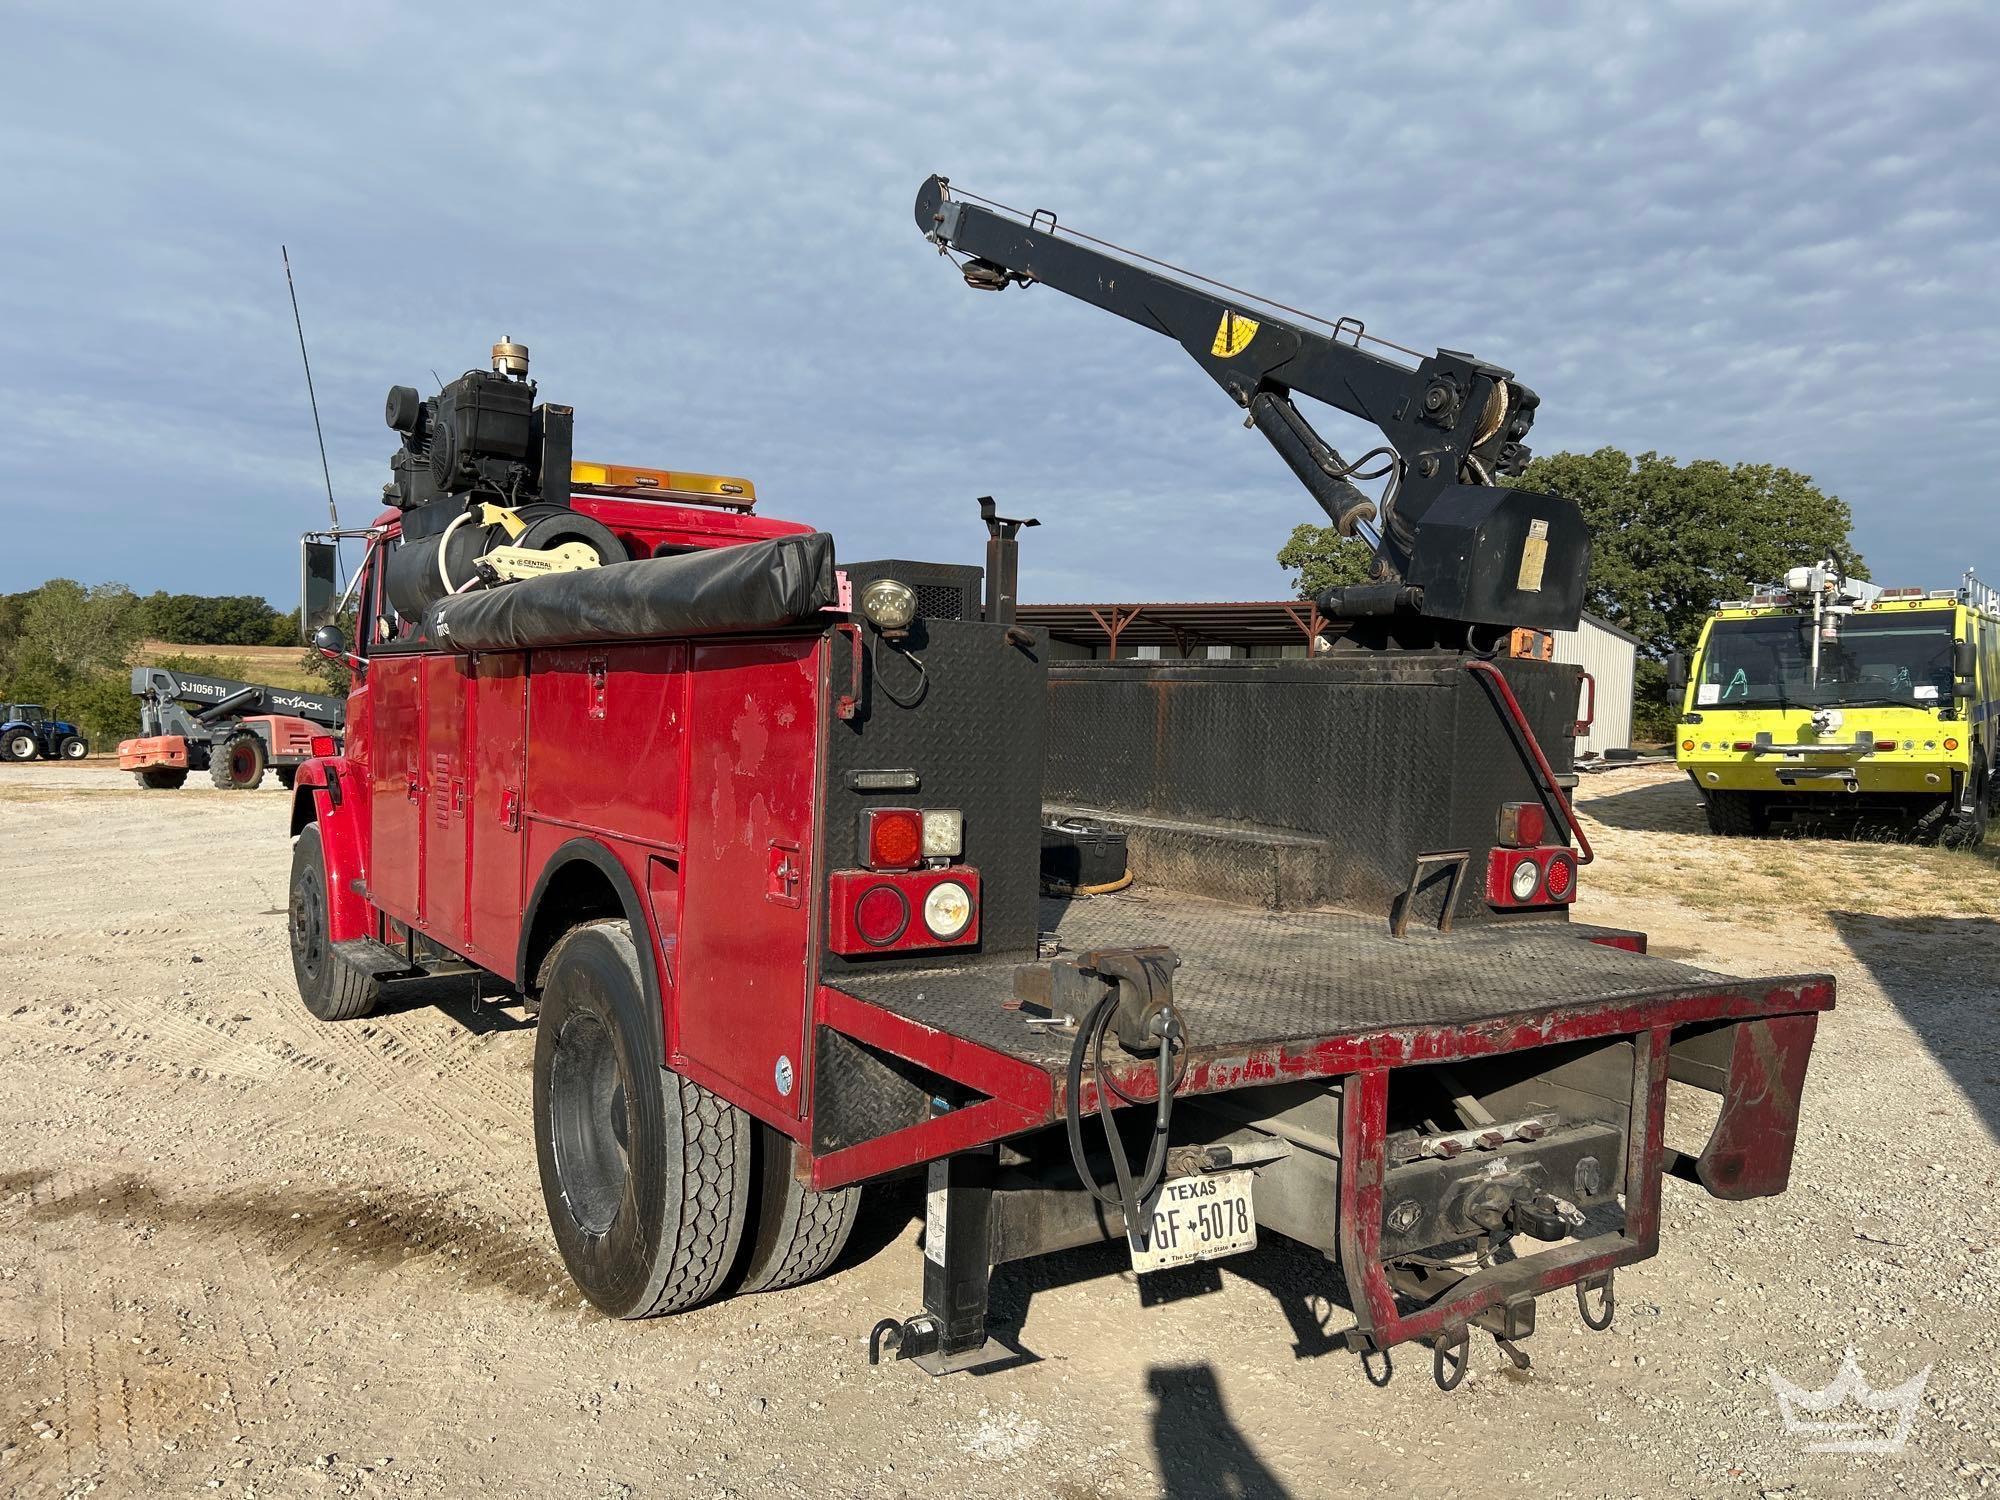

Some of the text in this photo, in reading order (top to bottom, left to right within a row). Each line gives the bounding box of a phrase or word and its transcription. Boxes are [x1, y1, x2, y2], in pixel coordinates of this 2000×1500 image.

[523, 559, 551, 568] CENTRAL
[180, 681, 226, 697] SJ1056 TH
[271, 695, 323, 711] SKYJACK
[1166, 1180, 1217, 1201] TEXAS
[1143, 1197, 1249, 1250] GF 5078
[1213, 1245, 1229, 1253] State
